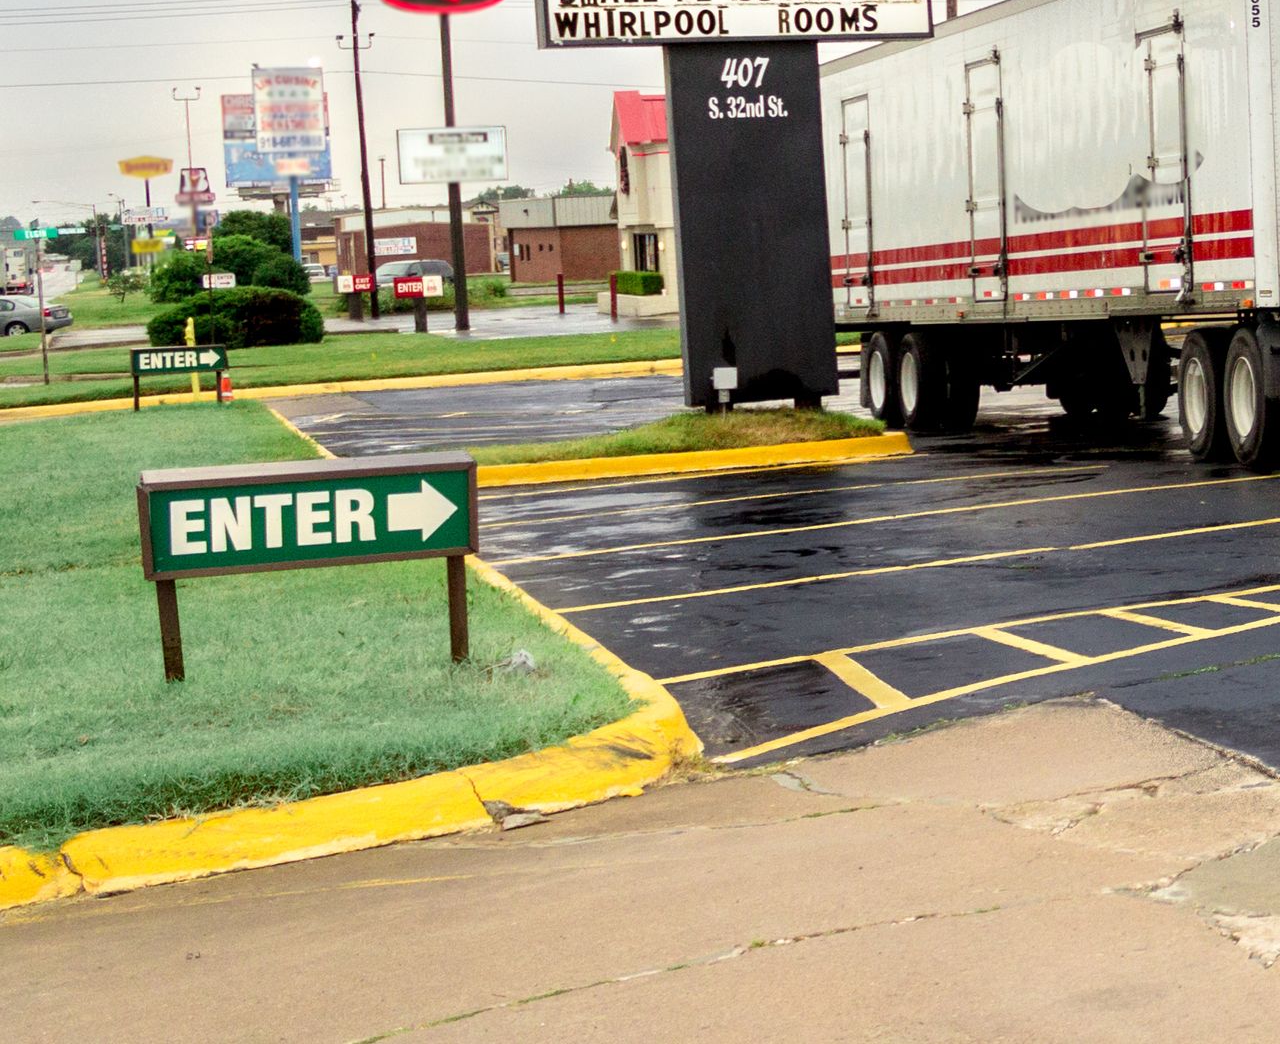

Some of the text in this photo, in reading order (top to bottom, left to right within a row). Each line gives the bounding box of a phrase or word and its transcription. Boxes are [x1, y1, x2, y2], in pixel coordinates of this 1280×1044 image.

[554, 5, 878, 38] WHIRLPOOL ROOMS
[720, 57, 769, 88] 407
[709, 95, 788, 119] S. 32nd St.
[397, 282, 423, 293] ENTER
[139, 351, 197, 370] ENTER
[169, 488, 377, 556] ENTER
